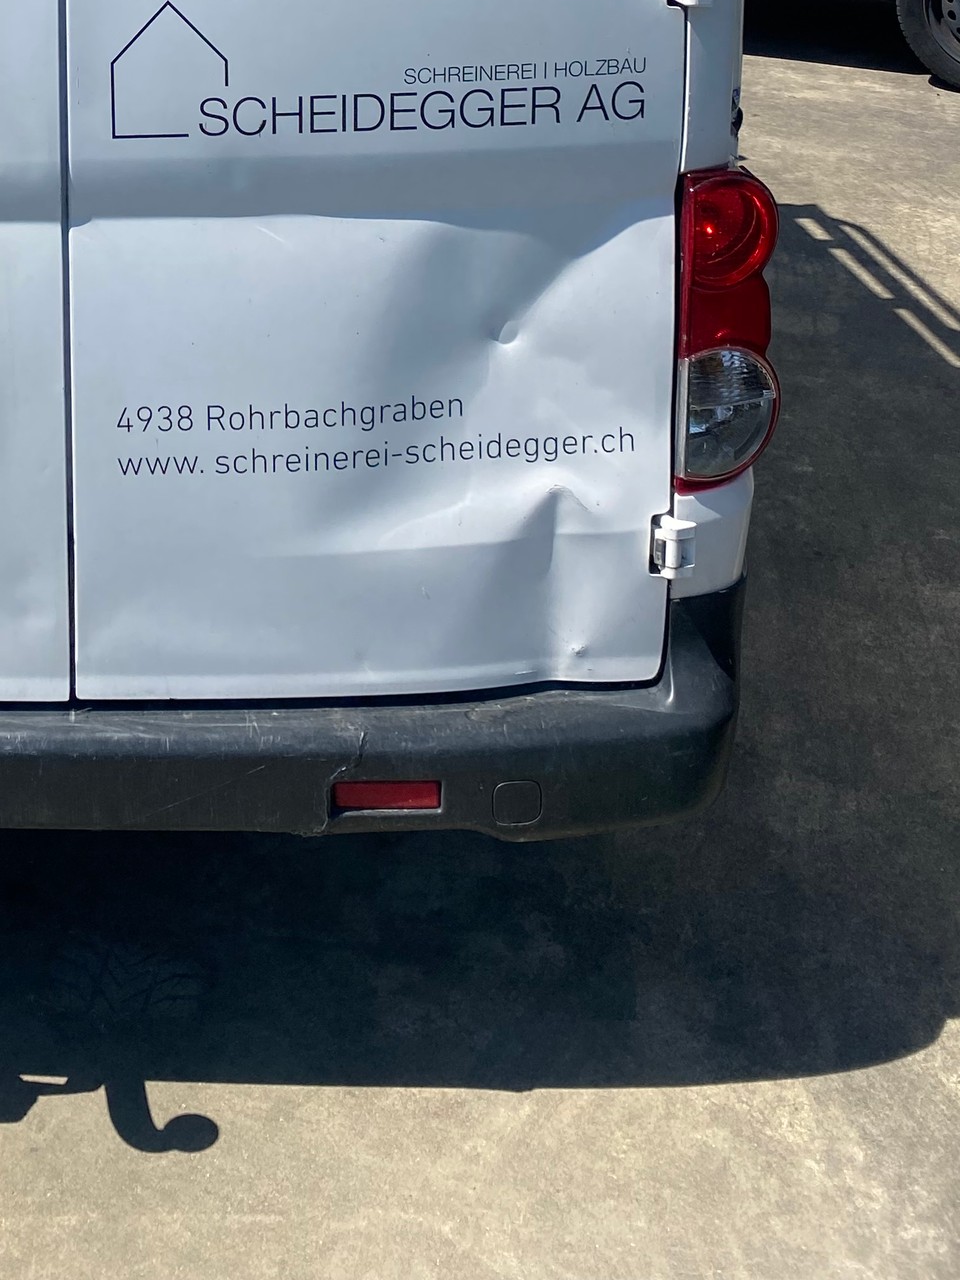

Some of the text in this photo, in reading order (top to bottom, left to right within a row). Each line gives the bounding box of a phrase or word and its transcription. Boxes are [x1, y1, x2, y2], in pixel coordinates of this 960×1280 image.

[403, 62, 538, 85] SCHREINEREI
[554, 56, 648, 79] HOLZBAU
[198, 81, 647, 137] SCHEIDEGGER AG
[116, 394, 464, 433] 4938 Rohrbachgraben
